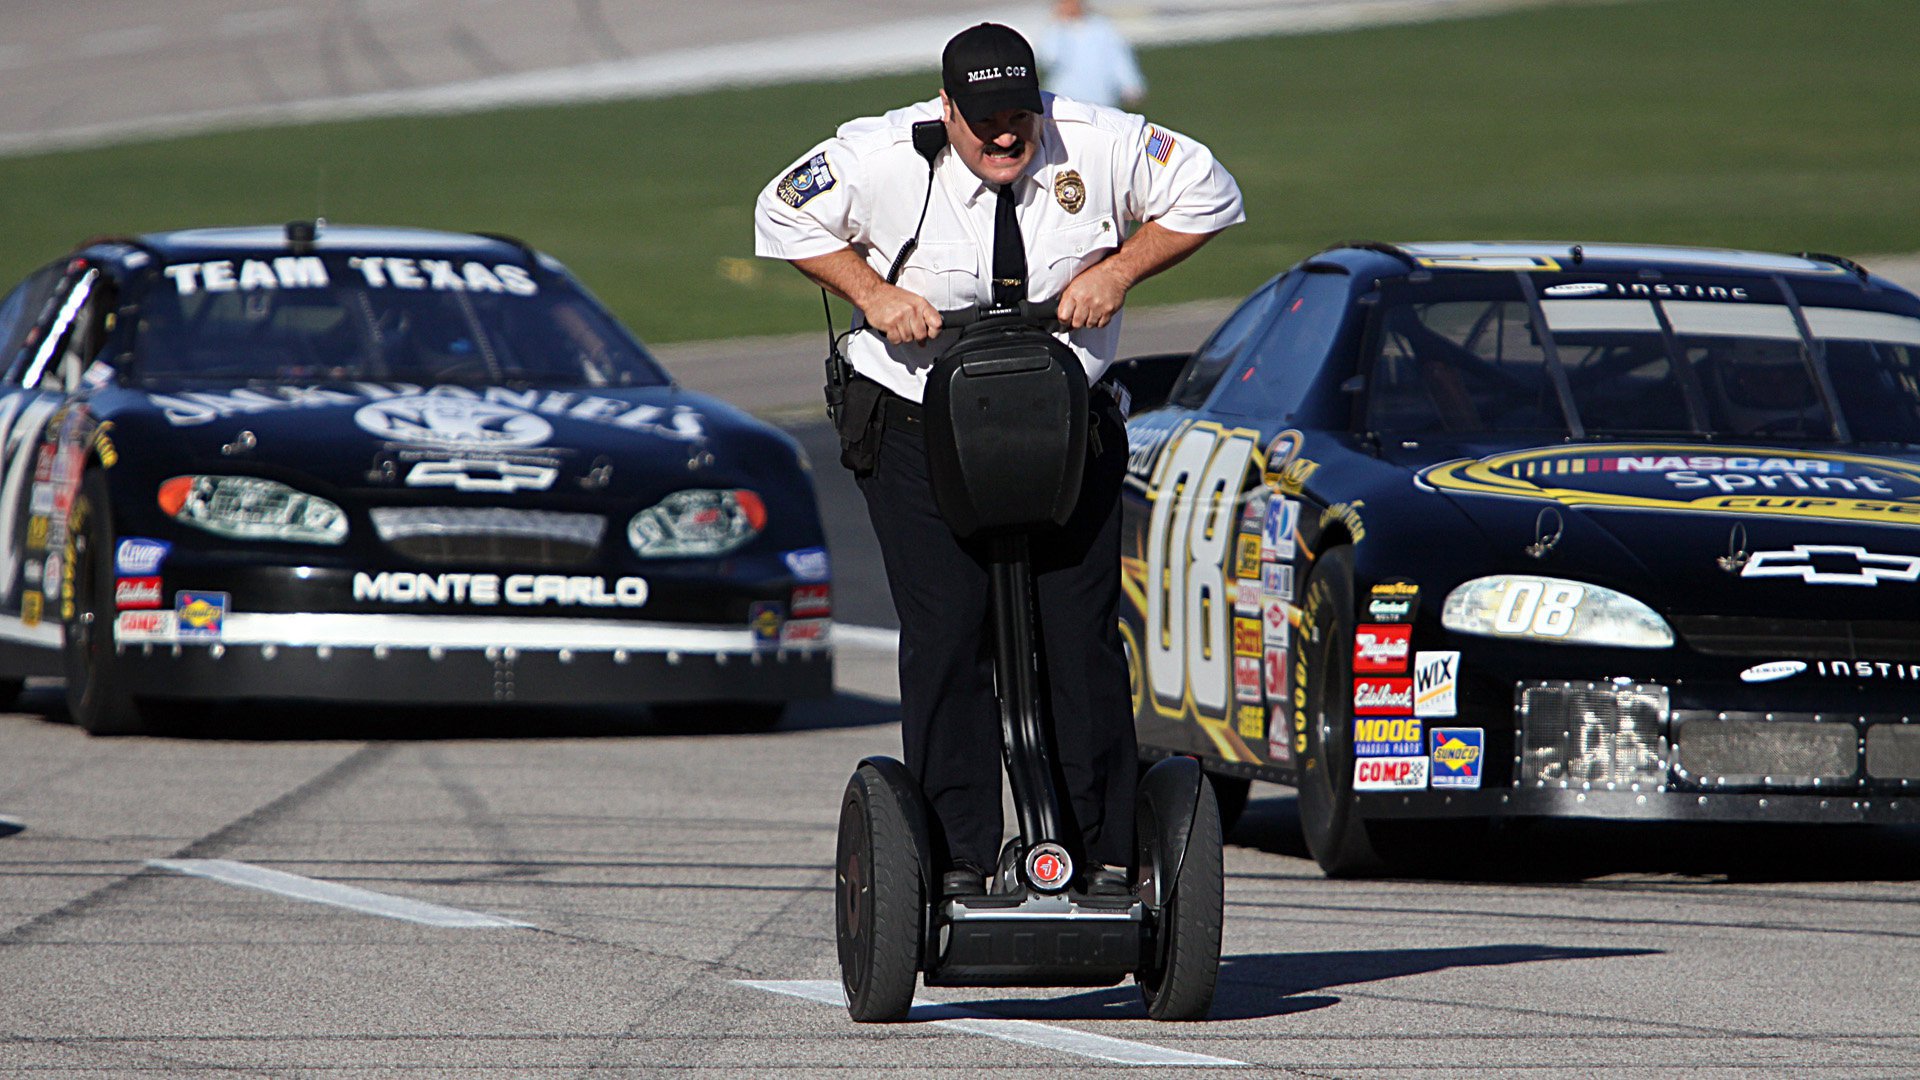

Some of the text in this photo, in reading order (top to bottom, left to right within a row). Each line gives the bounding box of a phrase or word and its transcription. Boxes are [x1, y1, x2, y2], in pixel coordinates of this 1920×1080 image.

[967, 66, 1027, 82] MALL COP
[164, 256, 538, 296] TEAM TEXAS
[1617, 456, 1830, 474] NASCAR
[1665, 470, 1893, 494] Sprint
[1717, 498, 1837, 509] CUP
[1145, 422, 1257, 718] 08
[353, 572, 648, 607] MONTE CARLO
[1495, 581, 1586, 637] 08
[1417, 655, 1453, 693] WIX
[1355, 683, 1413, 707] Edelbrock
[1355, 719, 1421, 743] MOOG
[1434, 747, 1477, 760] SUNOCO
[1359, 762, 1410, 782] COMP
